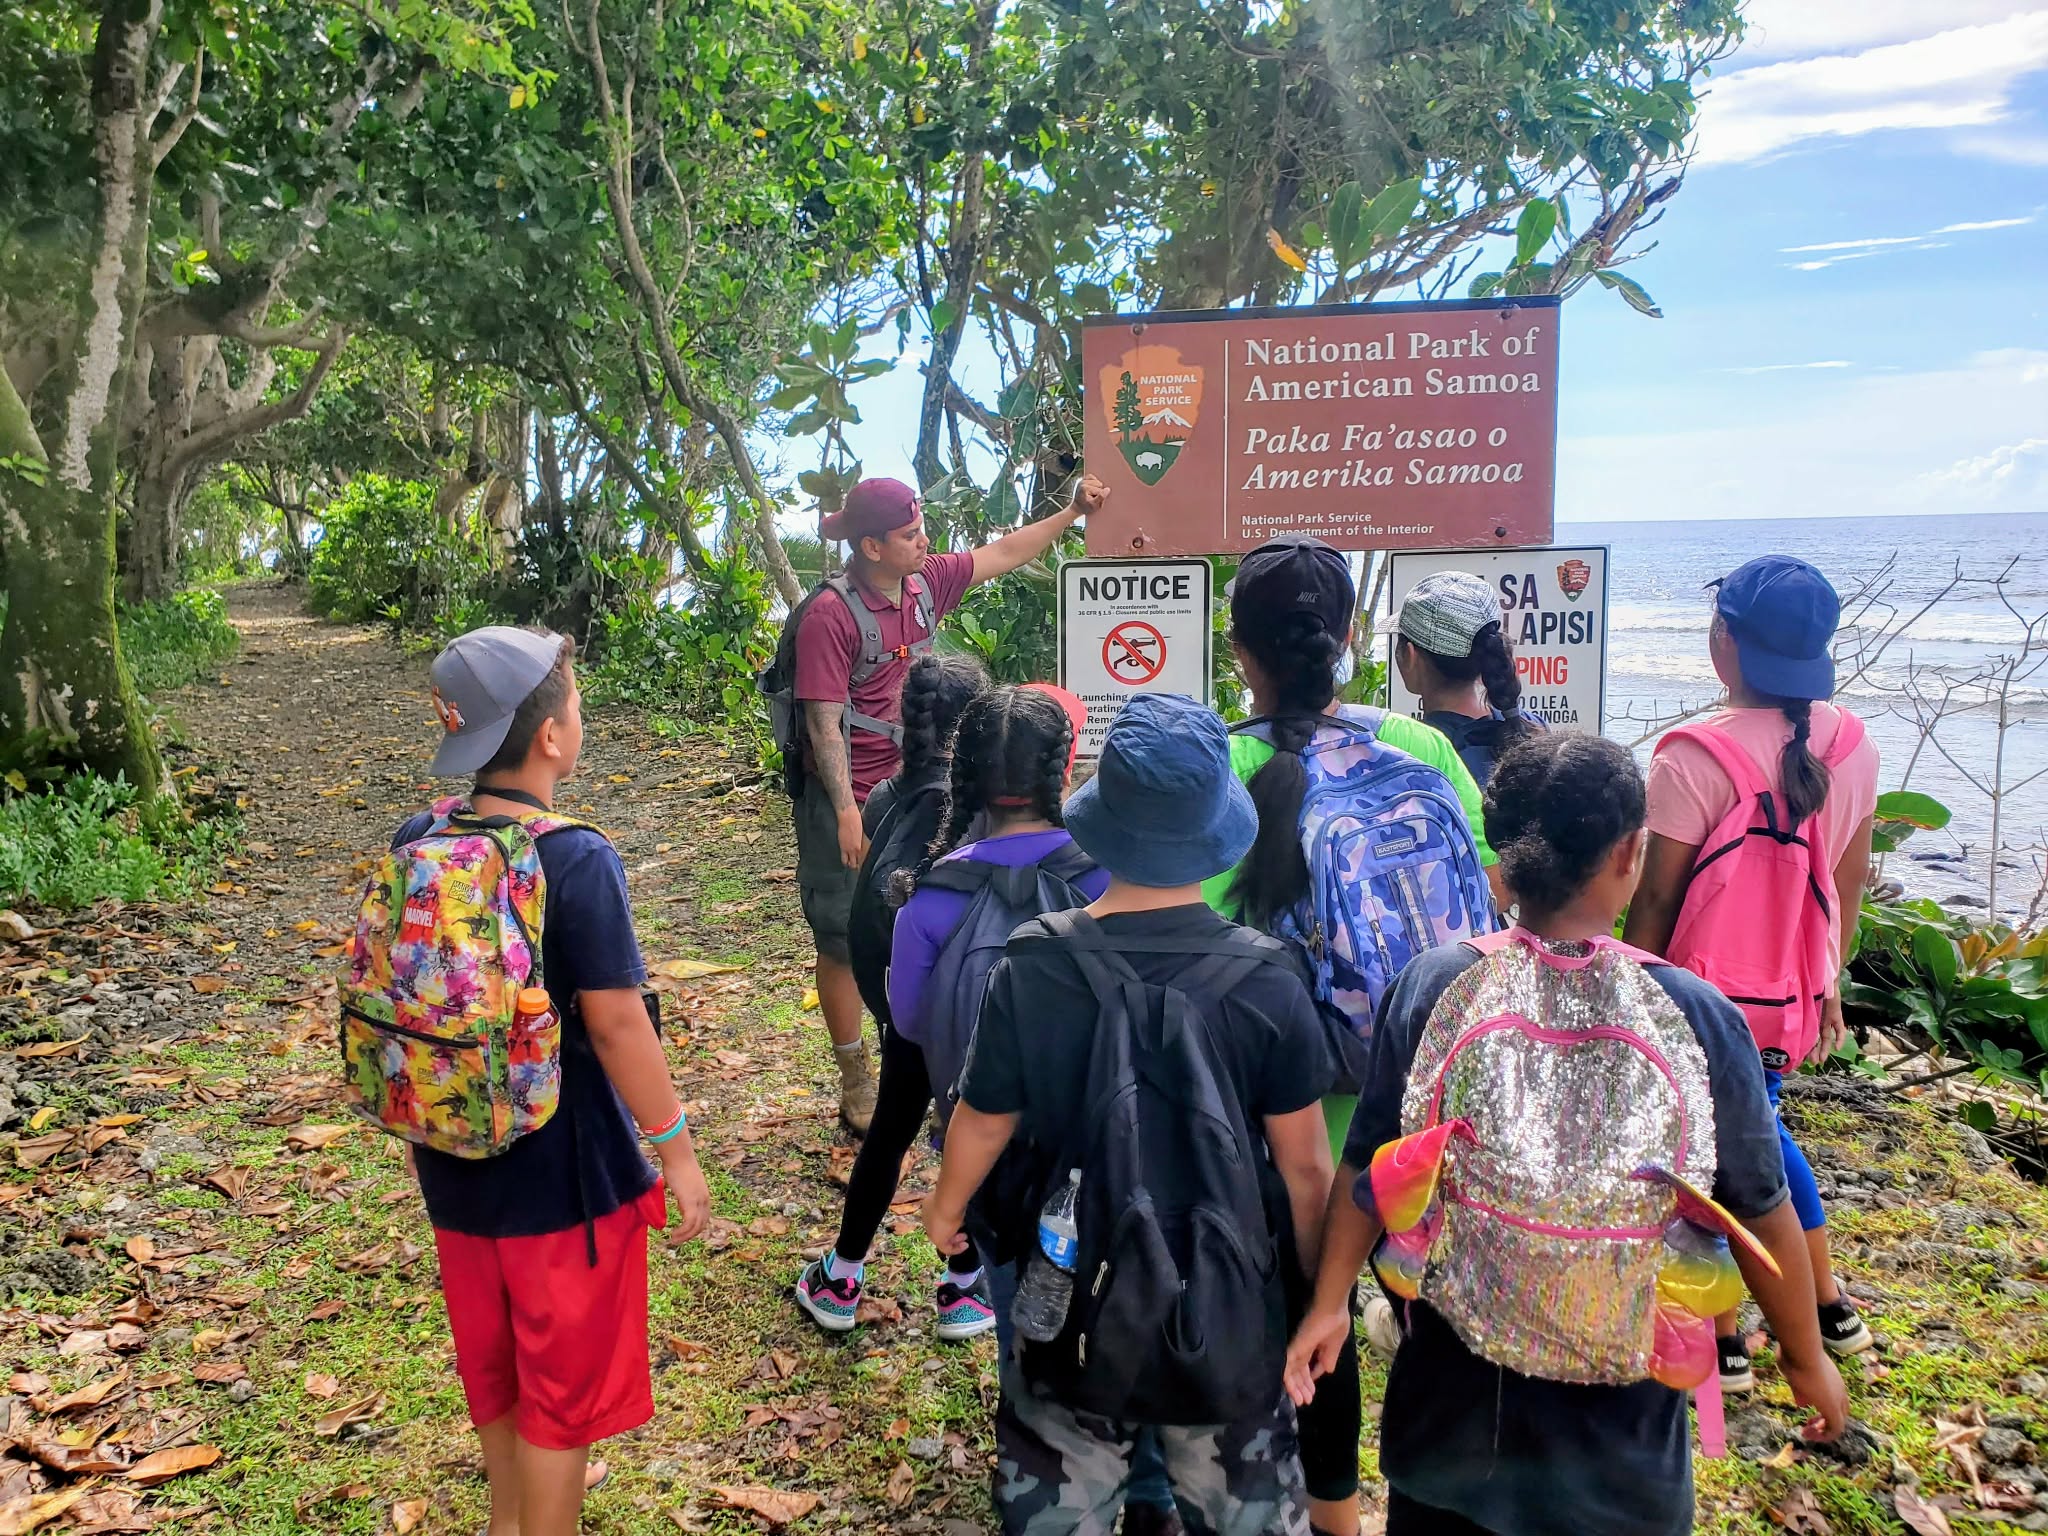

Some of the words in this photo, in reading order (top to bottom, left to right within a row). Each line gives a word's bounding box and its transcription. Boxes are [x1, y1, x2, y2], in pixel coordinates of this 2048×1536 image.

[1244, 332, 1396, 366] National
[1408, 329, 1490, 359] Park
[1502, 326, 1540, 357] of
[1140, 374, 1197, 385] NATIONAL
[1153, 385, 1184, 395] PARK
[1244, 371, 1414, 402] American
[1425, 368, 1541, 397] Samoa
[1145, 395, 1192, 407] SERVICE
[1243, 425, 1331, 455] Paka
[1487, 425, 1508, 448] o
[1241, 459, 1394, 490] Amerika
[1404, 457, 1524, 486] Samoa
[1242, 513, 1293, 526] National
[1298, 513, 1324, 524] Park
[1328, 511, 1372, 523] Service
[1242, 528, 1265, 539] U.S.
[1346, 525, 1359, 536] of
[1363, 525, 1383, 535] the
[1387, 523, 1434, 535] Interior
[1080, 575, 1190, 601] NOTICE
[1296, 591, 1320, 603] NIKE
[1500, 574, 1539, 610] SA
[1515, 656, 1568, 685] PING
[404, 907, 434, 928] MARVEL
